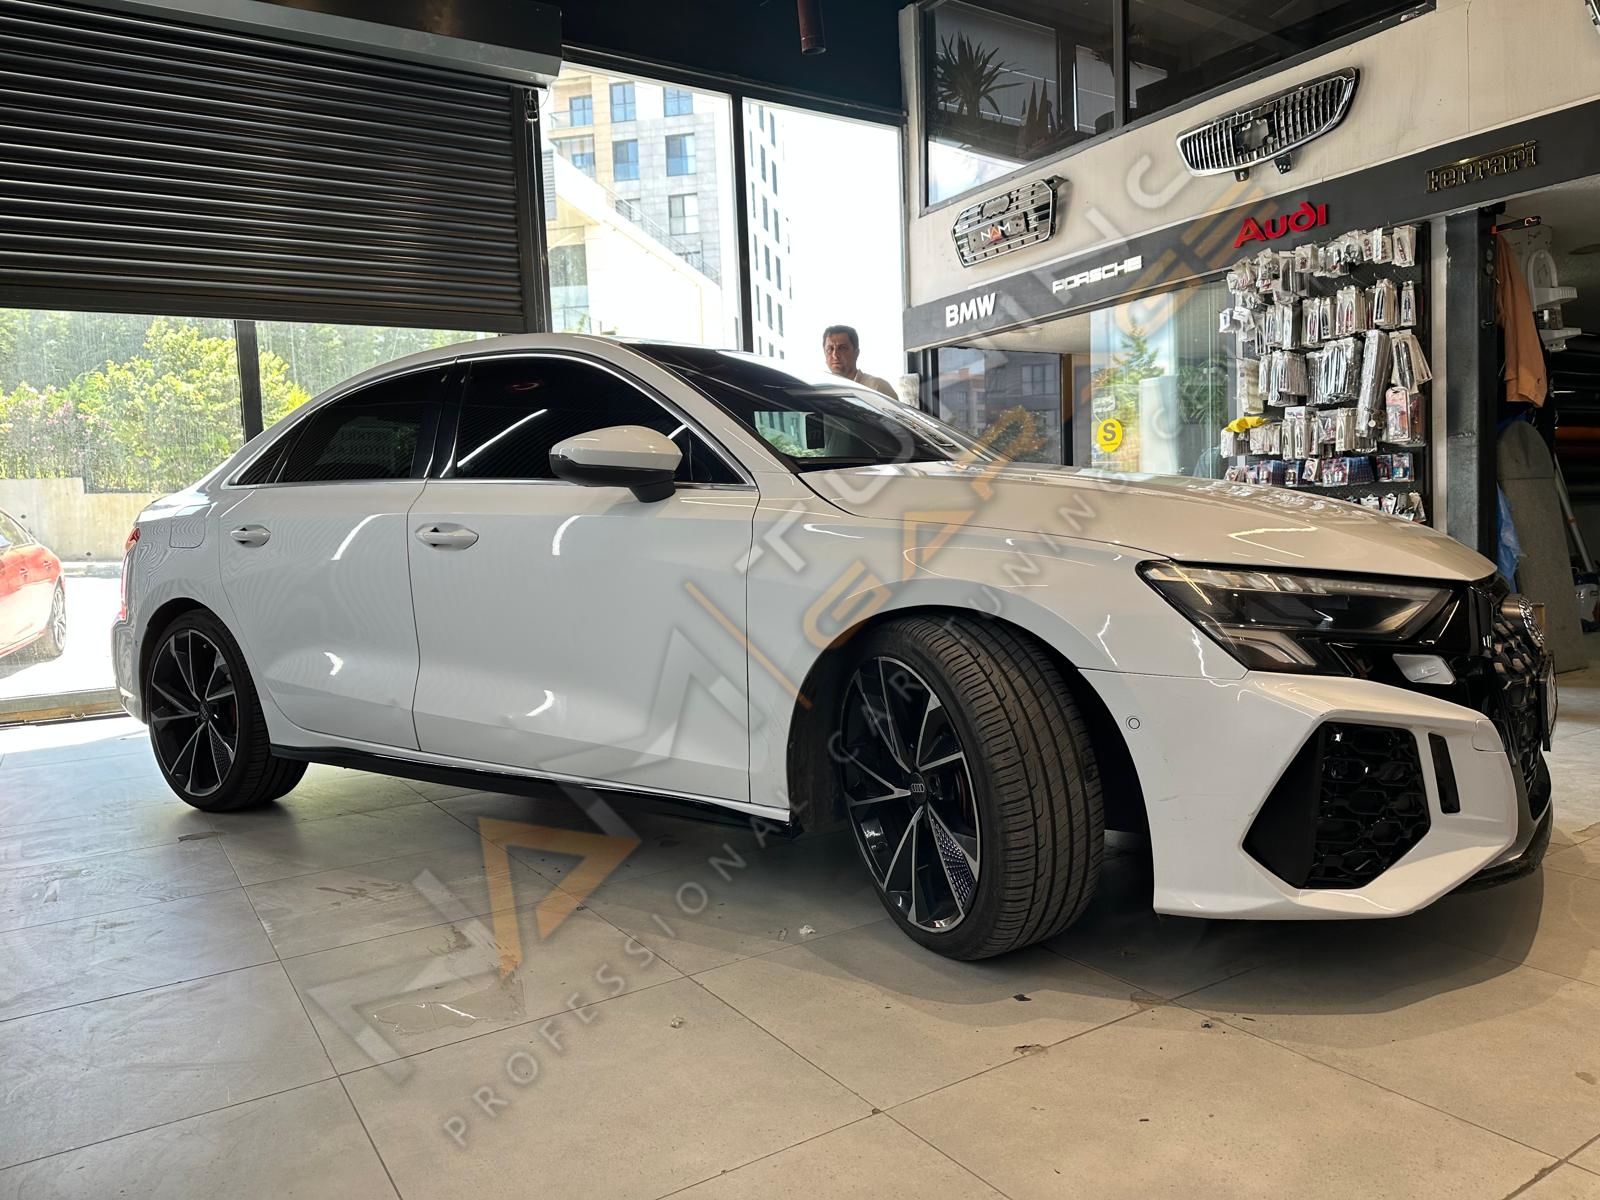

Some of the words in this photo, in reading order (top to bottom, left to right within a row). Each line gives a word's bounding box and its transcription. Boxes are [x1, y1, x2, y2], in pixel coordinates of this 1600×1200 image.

[1425, 139, 1538, 193] Ferrari
[1233, 201, 1328, 248] Audi
[1052, 255, 1143, 294] PORSCHE
[946, 292, 996, 327] BMW
